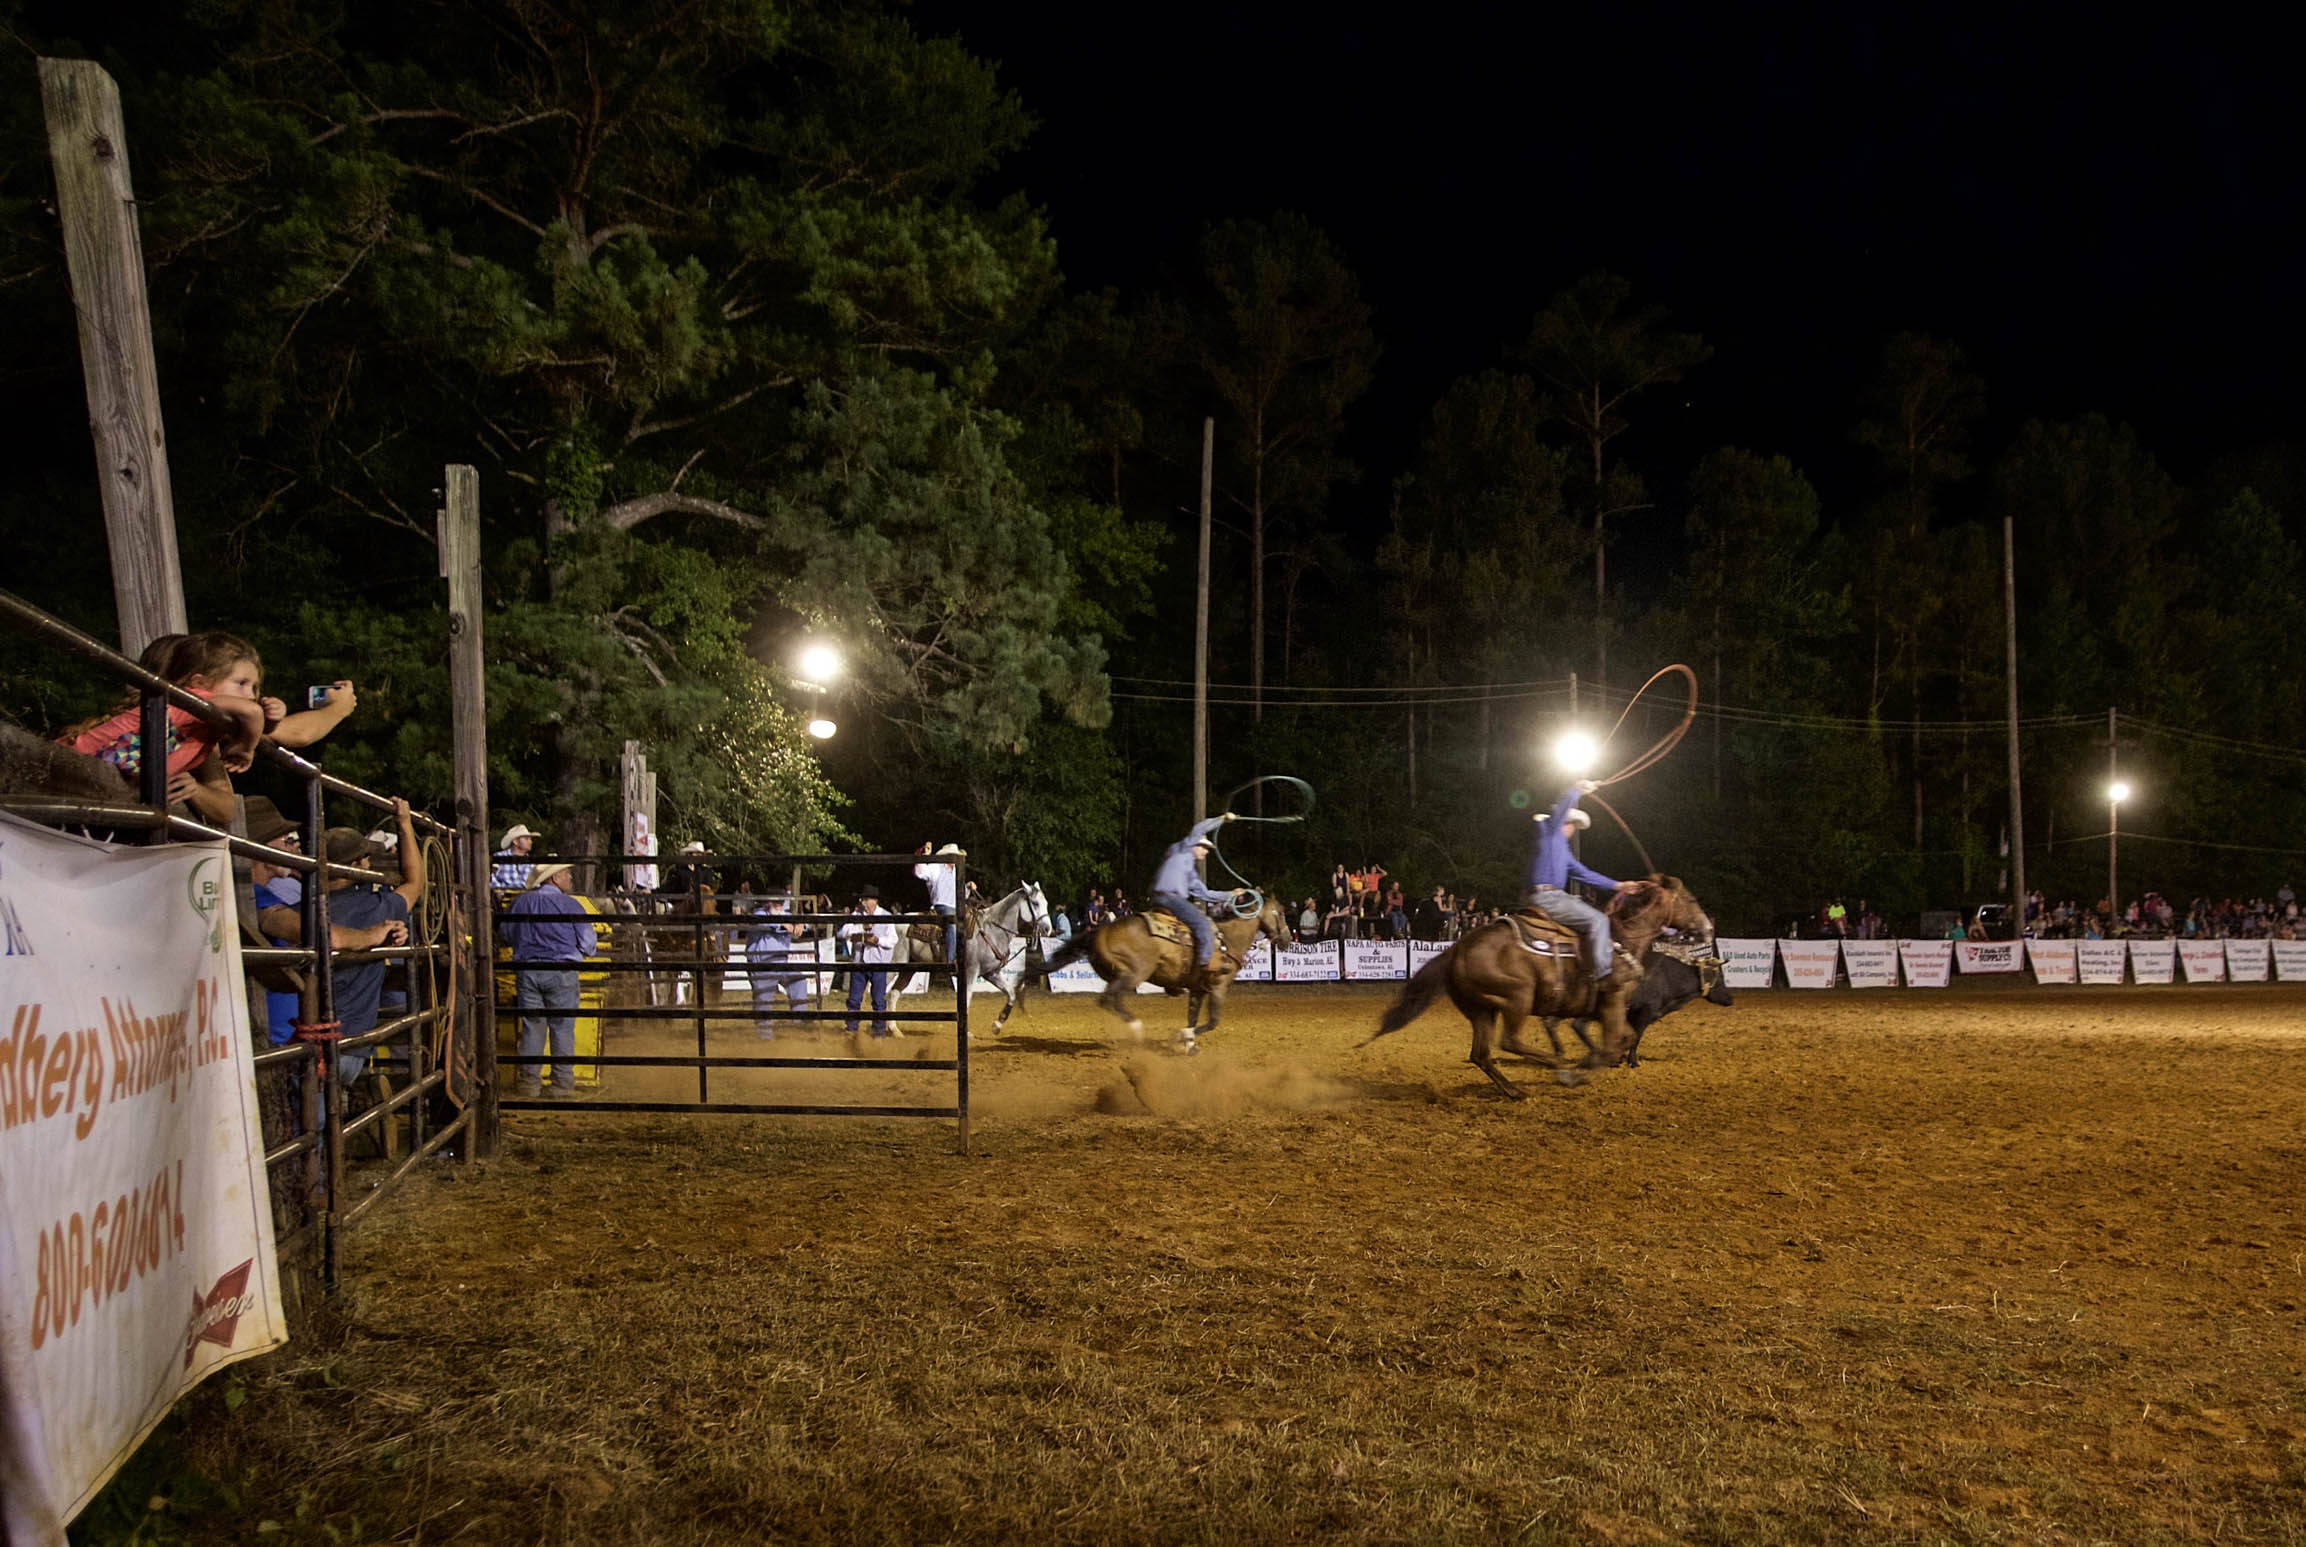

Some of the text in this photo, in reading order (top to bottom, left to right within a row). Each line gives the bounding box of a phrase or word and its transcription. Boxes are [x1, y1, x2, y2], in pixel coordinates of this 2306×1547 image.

[1277, 940, 1337, 954] RRISON TIRE
[1346, 940, 1365, 948] NAPA
[1358, 955, 1393, 963] SUPPLIES
